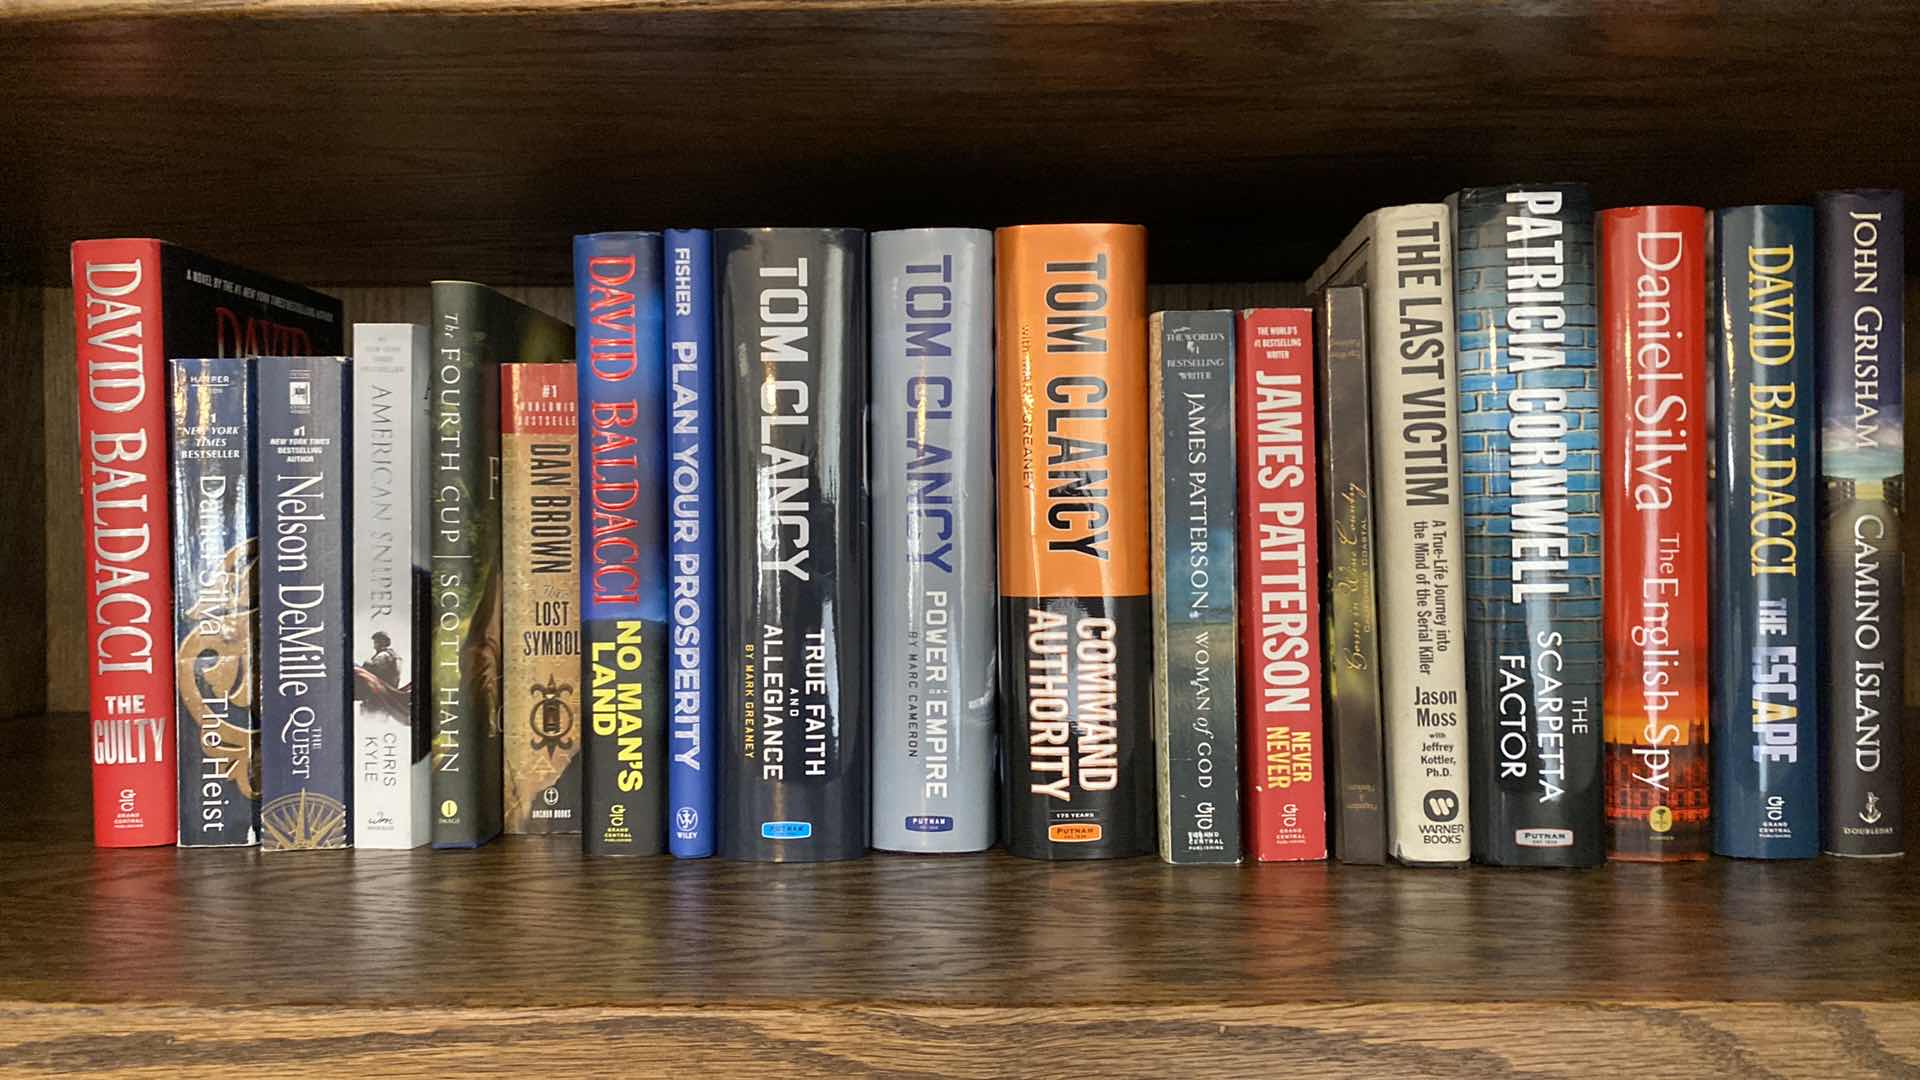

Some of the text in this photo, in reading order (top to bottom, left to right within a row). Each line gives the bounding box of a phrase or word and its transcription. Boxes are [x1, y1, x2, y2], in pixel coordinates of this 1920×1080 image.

[673, 247, 692, 317] FISHER
[444, 313, 460, 340] The
[1167, 332, 1225, 342] THE WORLD'S
[1254, 338, 1302, 348] #1 BESTSELLING
[1258, 326, 1298, 336] THE WORLD'S
[1266, 351, 1290, 359] WRITER
[1850, 211, 1883, 448] JOHN GRISHAM
[542, 384, 557, 398] #1
[1167, 359, 1224, 368] BESTSELLING
[1178, 372, 1212, 380] WRITER
[1396, 221, 1450, 507] THE LAST VICTIM
[1634, 231, 1687, 512] Daniel Silva
[759, 257, 811, 582] TOM CLANCY
[905, 254, 953, 573] TOM CLANCY
[1046, 253, 1110, 561] TOM CLANCY
[1506, 190, 1569, 604] PATRICIA CORNWELL
[1748, 245, 1797, 577] DAVID BALDACCI
[181, 449, 240, 459] BESTSELLER
[196, 438, 227, 447] TIMES
[211, 426, 240, 435] YORK
[270, 438, 330, 446] NEW YORK TIMES
[277, 446, 323, 454] BESTSELLING
[293, 426, 305, 437] #1
[369, 384, 393, 521] AMERICAN
[588, 255, 641, 606] DAVID BALDACCI
[1023, 412, 1034, 491] GREANEY
[86, 259, 153, 675] DAVID BALDACCI
[276, 471, 326, 572] Nelson
[530, 444, 571, 574] DAN BROWN
[1184, 392, 1209, 609] JAMES PATTERSON
[1335, 482, 1369, 545] Country
[439, 348, 461, 772] FOURTH CUP SCOTT HAHN
[671, 341, 702, 771] PLAN YOUR PROSPERITY
[1256, 371, 1311, 713] JAMES PATTERSON
[1433, 531, 1448, 580] True-Life
[1659, 536, 1680, 574] The
[199, 570, 229, 636] Silva
[369, 531, 393, 620] SNIPER
[1413, 521, 1434, 675] the Mind of the Serial Killer
[1433, 584, 1448, 626] Journey
[277, 584, 328, 697] DeMille
[523, 630, 581, 656] SYMBOL
[535, 601, 569, 626] LOST
[926, 591, 947, 682] POWER
[1436, 629, 1450, 651] into
[1631, 577, 1680, 711] English
[1758, 598, 1787, 636] THE
[1854, 514, 1885, 772] CAMINO ISLAND
[105, 694, 145, 714] THE
[201, 691, 229, 747] The
[592, 641, 616, 737] LAND
[616, 620, 644, 792] NO MAN'S
[744, 644, 755, 759] BY MARK GREANEY
[762, 624, 784, 780] ALLEGIANCE
[788, 687, 800, 718] AND
[804, 629, 827, 776] TRUE FAITH
[908, 631, 919, 758] BY MARC CAMERON
[1028, 608, 1071, 802] AUTHORITY
[1076, 617, 1119, 792] COMMAND
[1191, 631, 1214, 789] WOMAN of GOD
[1414, 686, 1457, 706] Jason
[1417, 708, 1457, 727] Moss
[1499, 655, 1527, 779] FACTOR
[1537, 631, 1566, 803] SCARPETTA
[1571, 697, 1588, 735] THE
[1751, 646, 1798, 763] ESCAPE
[94, 717, 166, 765] GUILTY
[282, 706, 316, 779] QUEST
[312, 727, 322, 749] THE
[365, 736, 379, 783] KYLE
[383, 732, 397, 788] CHRIS
[926, 701, 947, 798] EMPIRE
[1266, 726, 1292, 789] NEVER
[1291, 731, 1312, 783] NEVER
[1421, 755, 1457, 766] Kottler,
[1422, 742, 1454, 752] Jeffrey
[1631, 723, 1680, 791] Spy
[202, 757, 230, 832] Heist
[1426, 768, 1452, 777] Ph.D.
[554, 809, 571, 817] BOOKS
[912, 817, 945, 825] PUTNAM
[1419, 824, 1464, 834] WARNER
[1424, 834, 1462, 844] BOOKS
[1842, 826, 1893, 835] DOUBLEDAY
